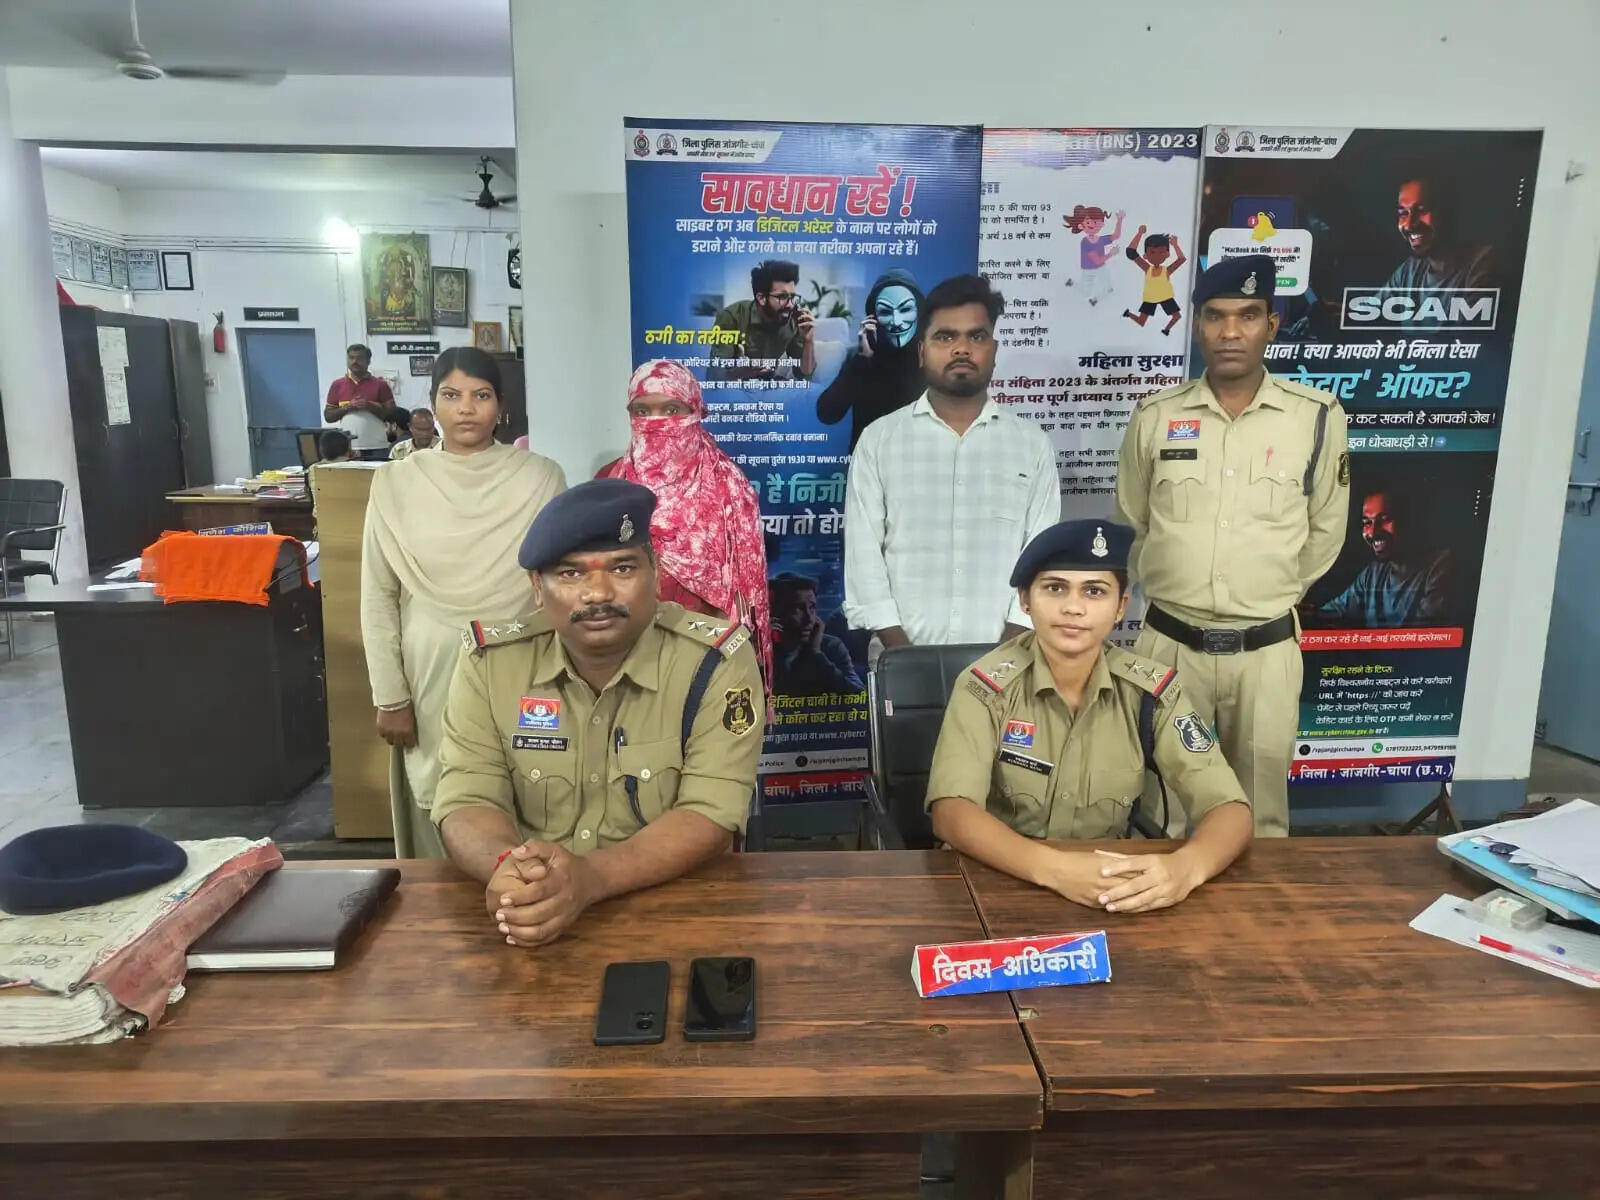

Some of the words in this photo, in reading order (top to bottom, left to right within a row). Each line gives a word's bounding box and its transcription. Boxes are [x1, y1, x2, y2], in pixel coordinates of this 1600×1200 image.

[1095, 131, 1141, 152] (BNS)
[1148, 133, 1198, 148] 2023
[701, 171, 842, 216] सावधान
[845, 163, 903, 217] रहें
[1040, 203, 1052, 212] 93
[675, 218, 714, 234] साइबर
[716, 219, 732, 234] ठग
[736, 219, 754, 234] अब
[756, 217, 799, 234] डिजिटल
[803, 218, 834, 235] अरेस्ट
[836, 218, 847, 234] के
[850, 220, 874, 235] नाम
[877, 220, 891, 235] पर
[893, 218, 922, 236] लोगों
[923, 218, 937, 236] को
[1004, 214, 1030, 224] समर्पित
[1002, 232, 1013, 240] 18
[691, 237, 721, 254] डराने
[724, 237, 745, 253] और
[748, 237, 774, 254] ठगने
[776, 239, 792, 254] का
[794, 239, 817, 254] नया
[819, 237, 852, 255] तरीका
[855, 239, 886, 255] अपना
[888, 238, 903, 256] रहे
[1348, 296, 1493, 321] SCAM
[644, 325, 674, 345] ठगी
[675, 329, 695, 345] का
[1303, 343, 1332, 360] क्या
[1333, 340, 1382, 360] आपको
[1384, 340, 1405, 360] भी
[1407, 339, 1447, 359] मिला
[1447, 339, 1481, 359] ऐसा
[1078, 351, 1134, 369] महिला
[1137, 353, 1184, 371] सुरक्षा
[1007, 376, 1045, 389] संहिता
[1049, 377, 1081, 387] 2023
[1085, 375, 1098, 387] के
[1101, 374, 1141, 387] अंतर्गत
[1144, 373, 1184, 387] महिला
[1376, 363, 1472, 399] ऑफर?
[776, 403, 784, 411] या
[1027, 394, 1044, 404] पर
[1047, 391, 1069, 408] पूर्ण
[1072, 392, 1112, 402] अध्याय
[1116, 392, 1123, 401] 5
[721, 414, 744, 423] बनकर
[1034, 411, 1045, 419] 69
[1059, 411, 1074, 420] तहत
[1078, 410, 1100, 419] पहचान
[1356, 413, 1377, 425] कट
[1379, 410, 1414, 424] सकती
[1416, 410, 1426, 425] है
[1428, 410, 1468, 424] आपकी
[736, 432, 752, 442] देकर
[753, 431, 784, 442] मानसिक
[748, 456, 770, 467] सूचना
[788, 455, 806, 464] 1930
[807, 455, 816, 464] या
[793, 508, 816, 535] तो
[1300, 764, 1328, 779] जिला
[1339, 761, 1412, 778] जांजगीर-चांपा
[932, 953, 993, 984] दिवस
[1003, 941, 1096, 976] अधिकारी
